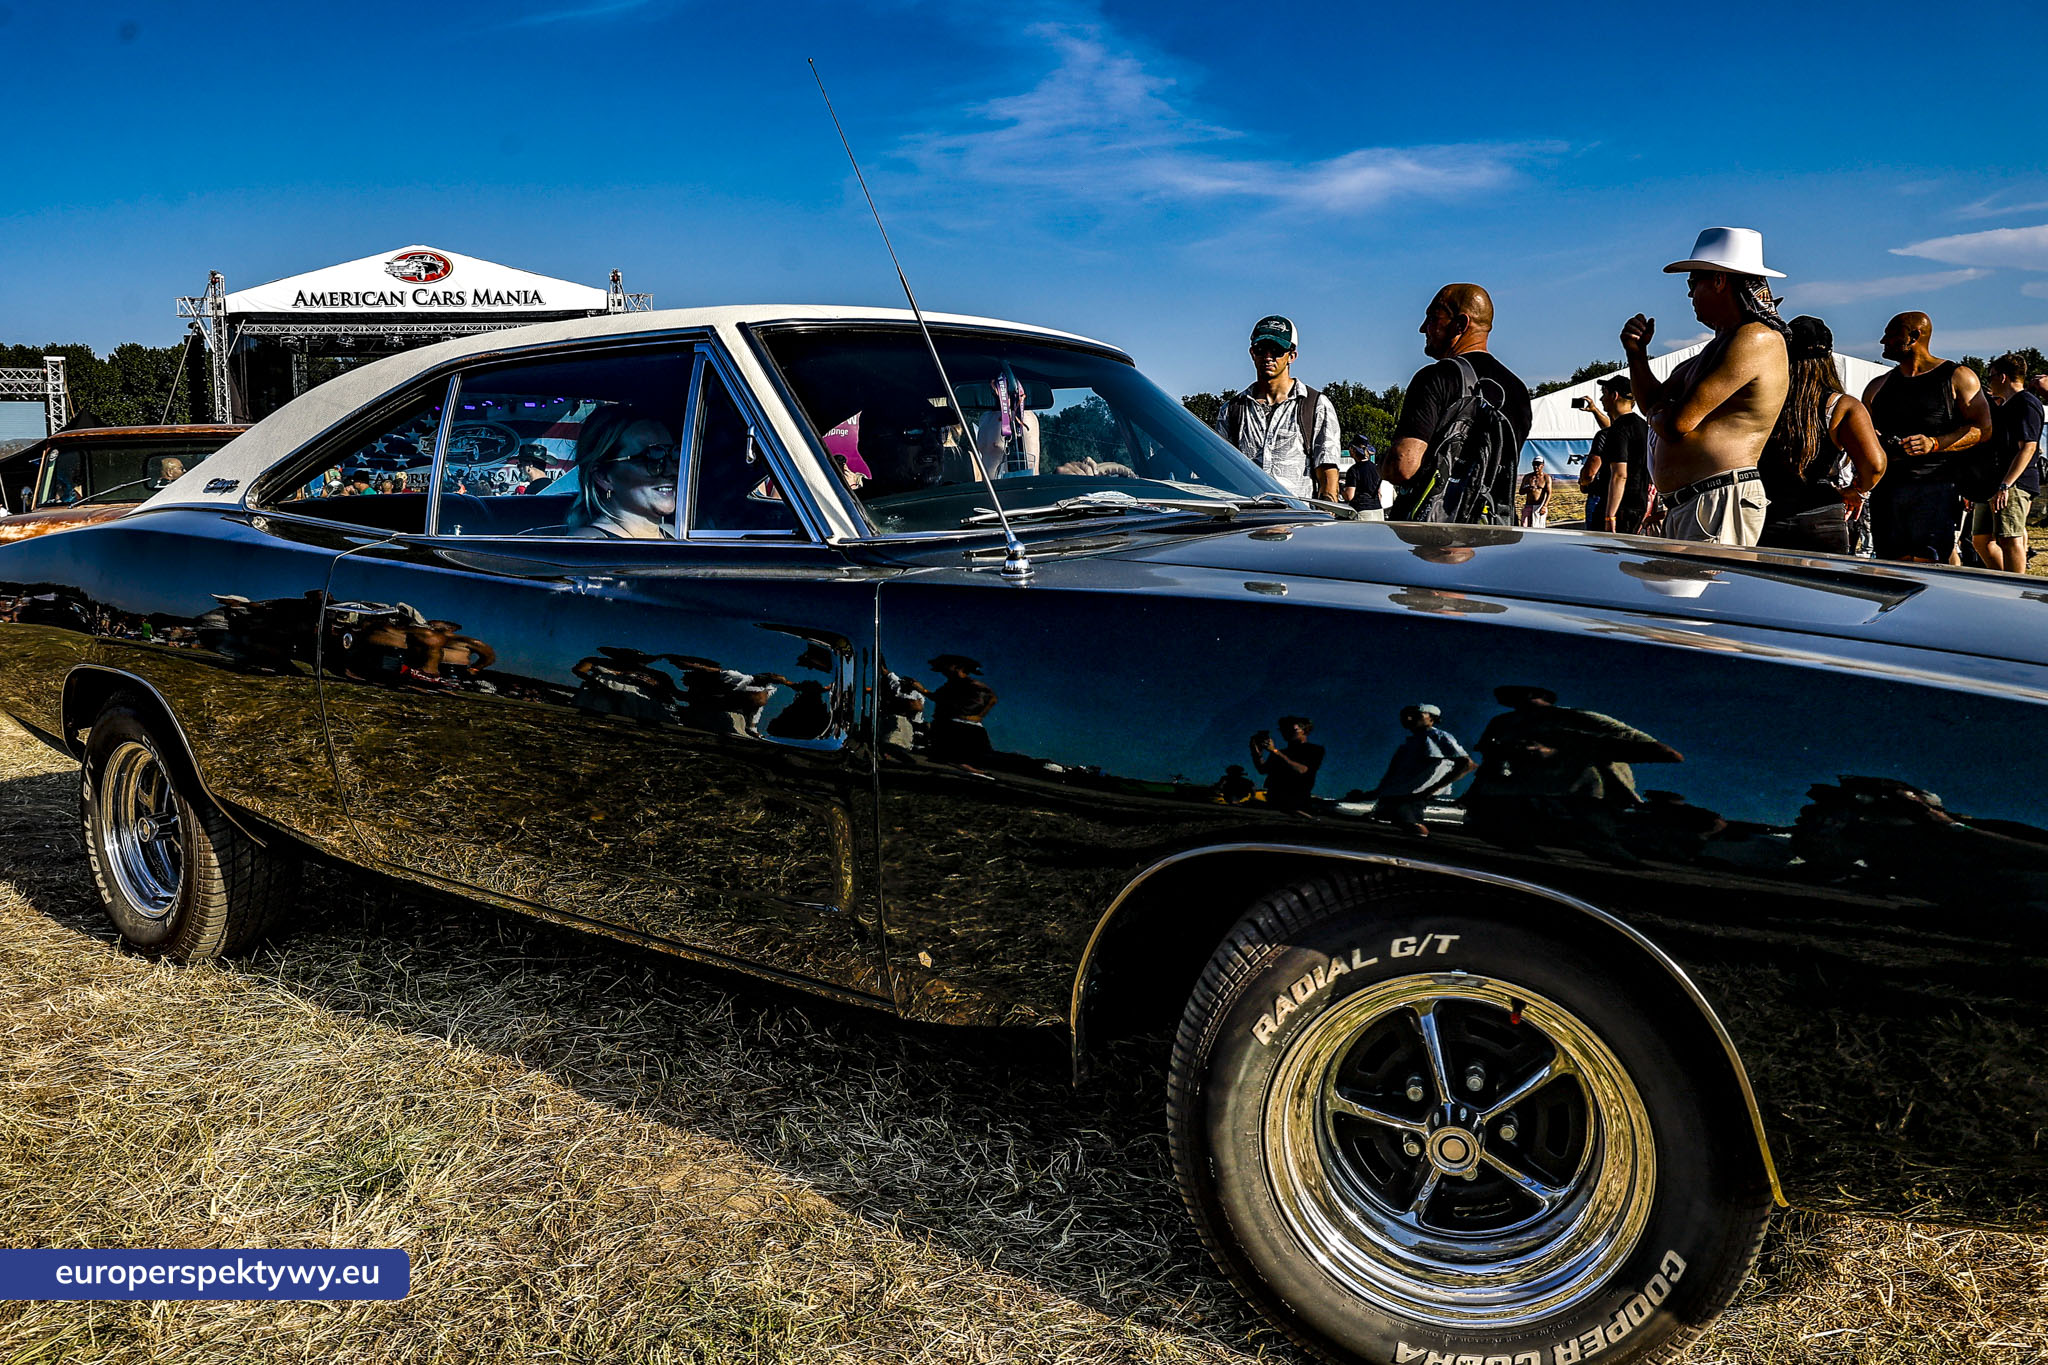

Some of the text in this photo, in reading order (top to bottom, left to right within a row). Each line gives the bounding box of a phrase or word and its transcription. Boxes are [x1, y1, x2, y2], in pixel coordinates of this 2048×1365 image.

[84, 814, 112, 905] RADIAL
[1251, 948, 1379, 1046] RADIAL
[1390, 933, 1461, 958] G/T
[1553, 1250, 1687, 1365] COOPER
